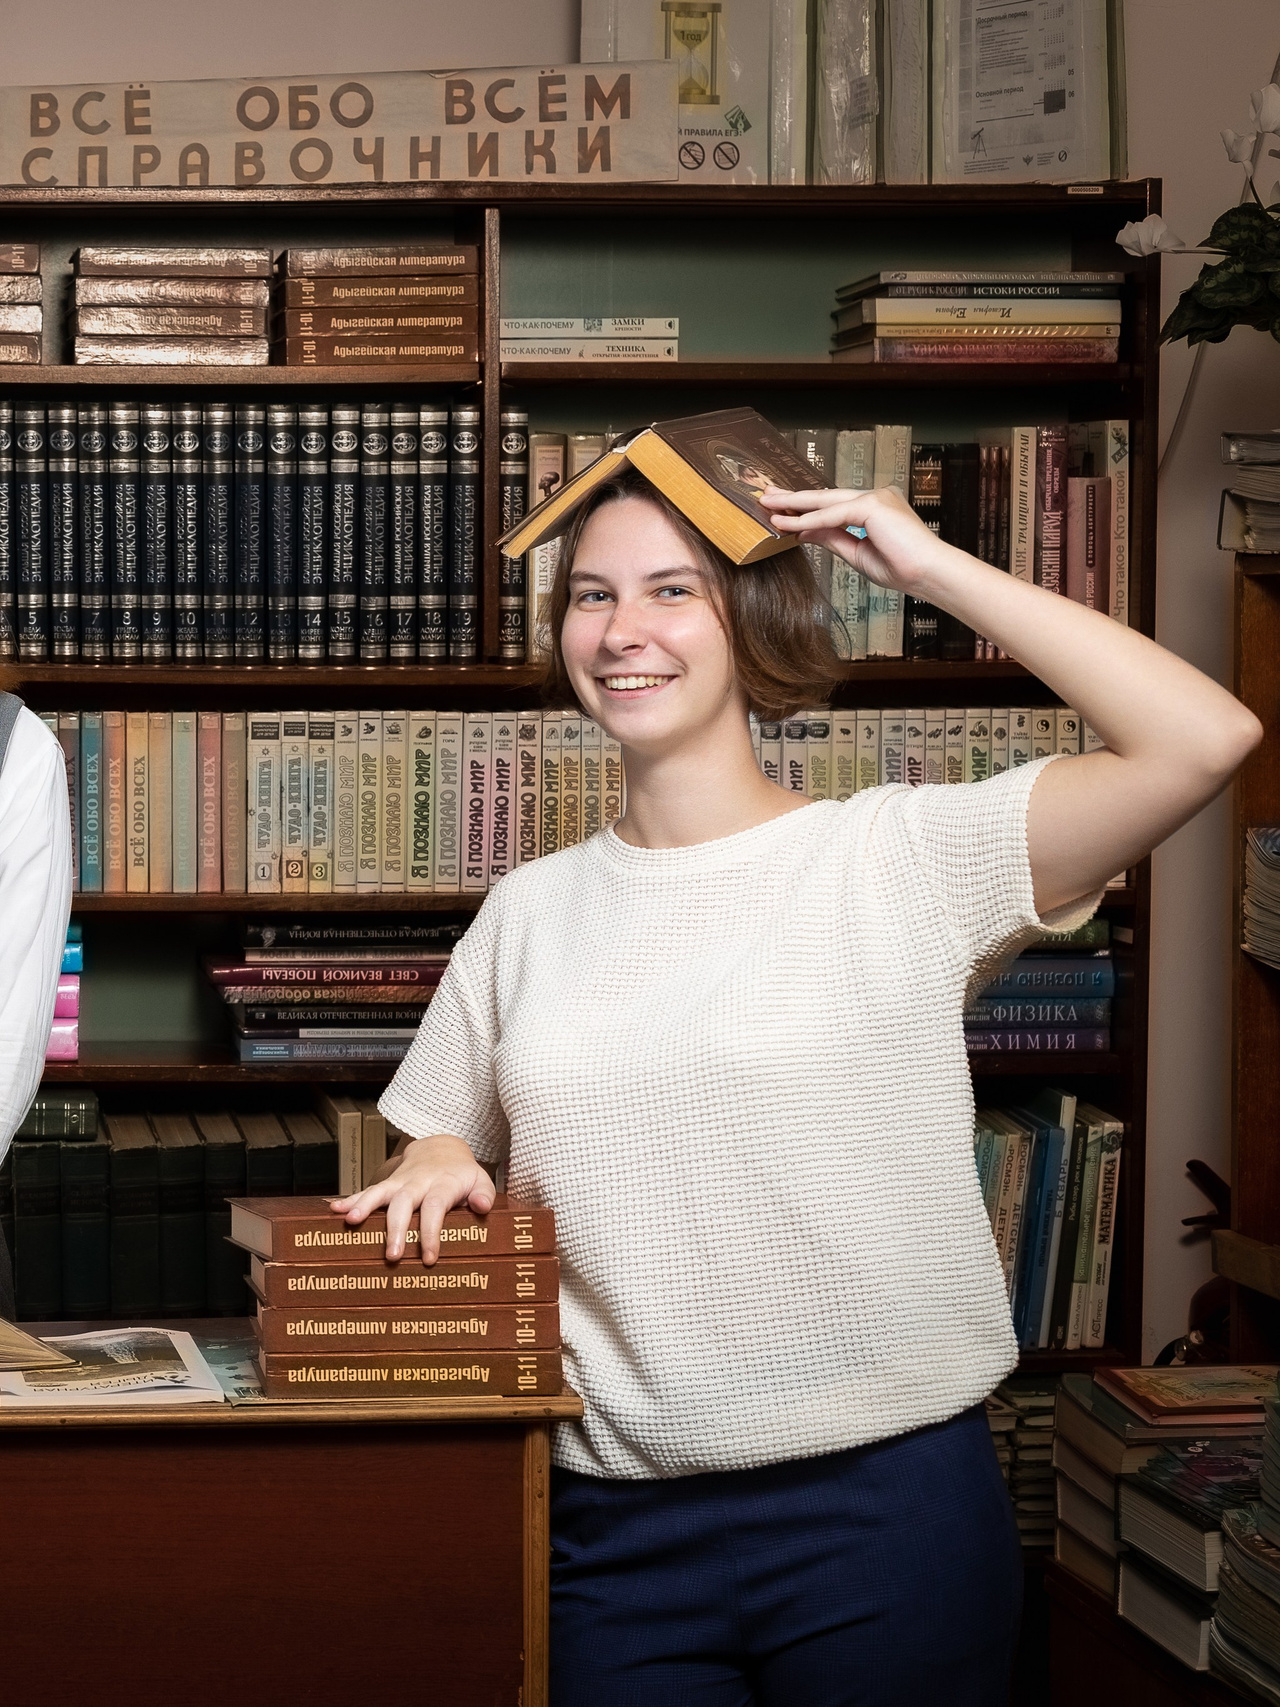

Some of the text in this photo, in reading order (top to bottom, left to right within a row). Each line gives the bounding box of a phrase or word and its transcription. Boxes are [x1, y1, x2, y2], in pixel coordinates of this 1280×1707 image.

[30, 69, 631, 137] ВСЁ ОБО ВСЁМ
[684, 128, 723, 137] ПРАВИЛА
[21, 125, 611, 186] СПРАВОЧНИКИ
[12, 246, 25, 269] 10-11
[302, 282, 315, 305] 10-11
[332, 285, 464, 298] Адыгейская литература
[974, 286, 1060, 295] ИСТОКИ РОССИИ
[935, 306, 967, 319] Европы
[300, 312, 313, 336] 10-11
[330, 316, 463, 330] Адыгейская литература
[611, 318, 645, 326] ЗАМКИ
[303, 340, 316, 364] 10-11
[333, 344, 464, 356] Адыгейская литература
[1018, 434, 1029, 477] ОБЫЧАИ
[1017, 490, 1029, 544] ТРАДИЦИИ
[0, 483, 10, 581] ЭНЦИКЛОПЕДИЯ
[126, 484, 136, 583] ЭНЦИКЛОПЕДИЯ
[312, 486, 323, 584] ЭНЦИКЛОПЕДИЯ
[1041, 510, 1064, 547] НАРОД
[1113, 470, 1125, 616] Что такое Кто такой
[1085, 572, 1095, 598] РОССИИ
[28, 612, 37, 624] 5
[122, 612, 131, 625] 8
[152, 612, 161, 625] 9
[179, 612, 195, 625] 10
[304, 613, 321, 626] 14
[334, 611, 351, 625] 15
[396, 613, 413, 625] 17
[424, 612, 441, 625] 18
[503, 613, 521, 626] 20
[83, 753, 99, 866] ВСЁ ОБО ВСЕХ
[130, 755, 145, 867] ВСЁ ОБО ВСЕХ
[200, 756, 216, 868] ВСЁ ОБО ВСЕХ
[411, 748, 431, 878] Я ПОЗНАЮ МИР
[466, 759, 485, 878] Я ПОЗНАЮ МИР
[491, 757, 510, 876] Я ПОЗНАЮ МИР
[261, 866, 267, 878] 1
[290, 863, 299, 875] 2
[315, 865, 324, 878] 3
[263, 969, 419, 983] СВЕТ ВЕЛИКОЙ ПОБЕДЫ
[277, 1011, 393, 1020] ВЕЛИКАЯ ОТЕЧЕСТВЕННАЯ
[993, 1005, 1078, 1022] ФИЗИКА
[991, 1034, 1076, 1050] ХИМИЯ
[1098, 1157, 1118, 1246] МАТЕМАТИКА
[294, 1230, 386, 1248] итература
[514, 1214, 533, 1251] 10-11
[287, 1273, 489, 1291] Адыгейская литература
[516, 1263, 536, 1298] 10-11
[286, 1319, 489, 1336] Адыгейская литература
[516, 1309, 536, 1344] 10-11
[288, 1364, 490, 1383] Адыгейская литература
[518, 1355, 538, 1391] 10-11
